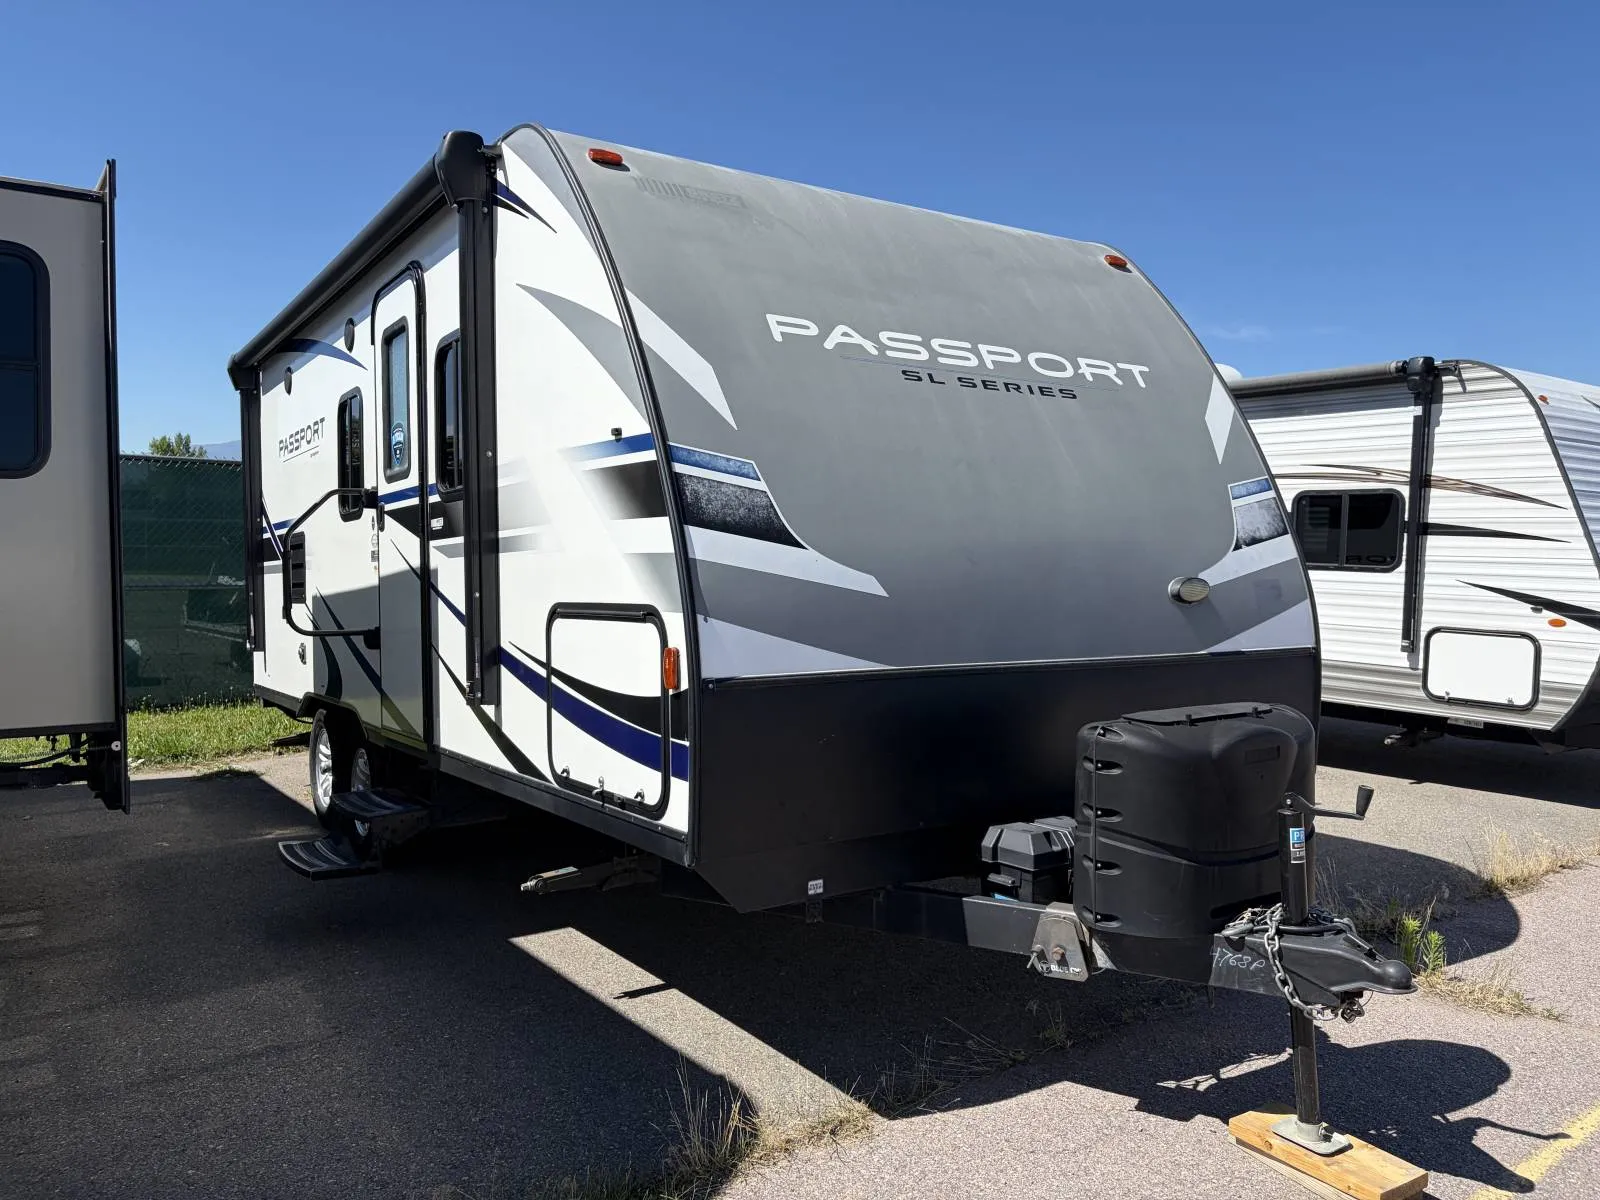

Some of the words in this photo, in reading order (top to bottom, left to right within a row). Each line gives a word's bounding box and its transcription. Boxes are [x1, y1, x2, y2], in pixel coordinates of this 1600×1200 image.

[765, 313, 1150, 389] PASSPORT
[901, 369, 946, 386] SL
[956, 375, 1078, 400] SERIES
[278, 416, 326, 458] PASSPORT
